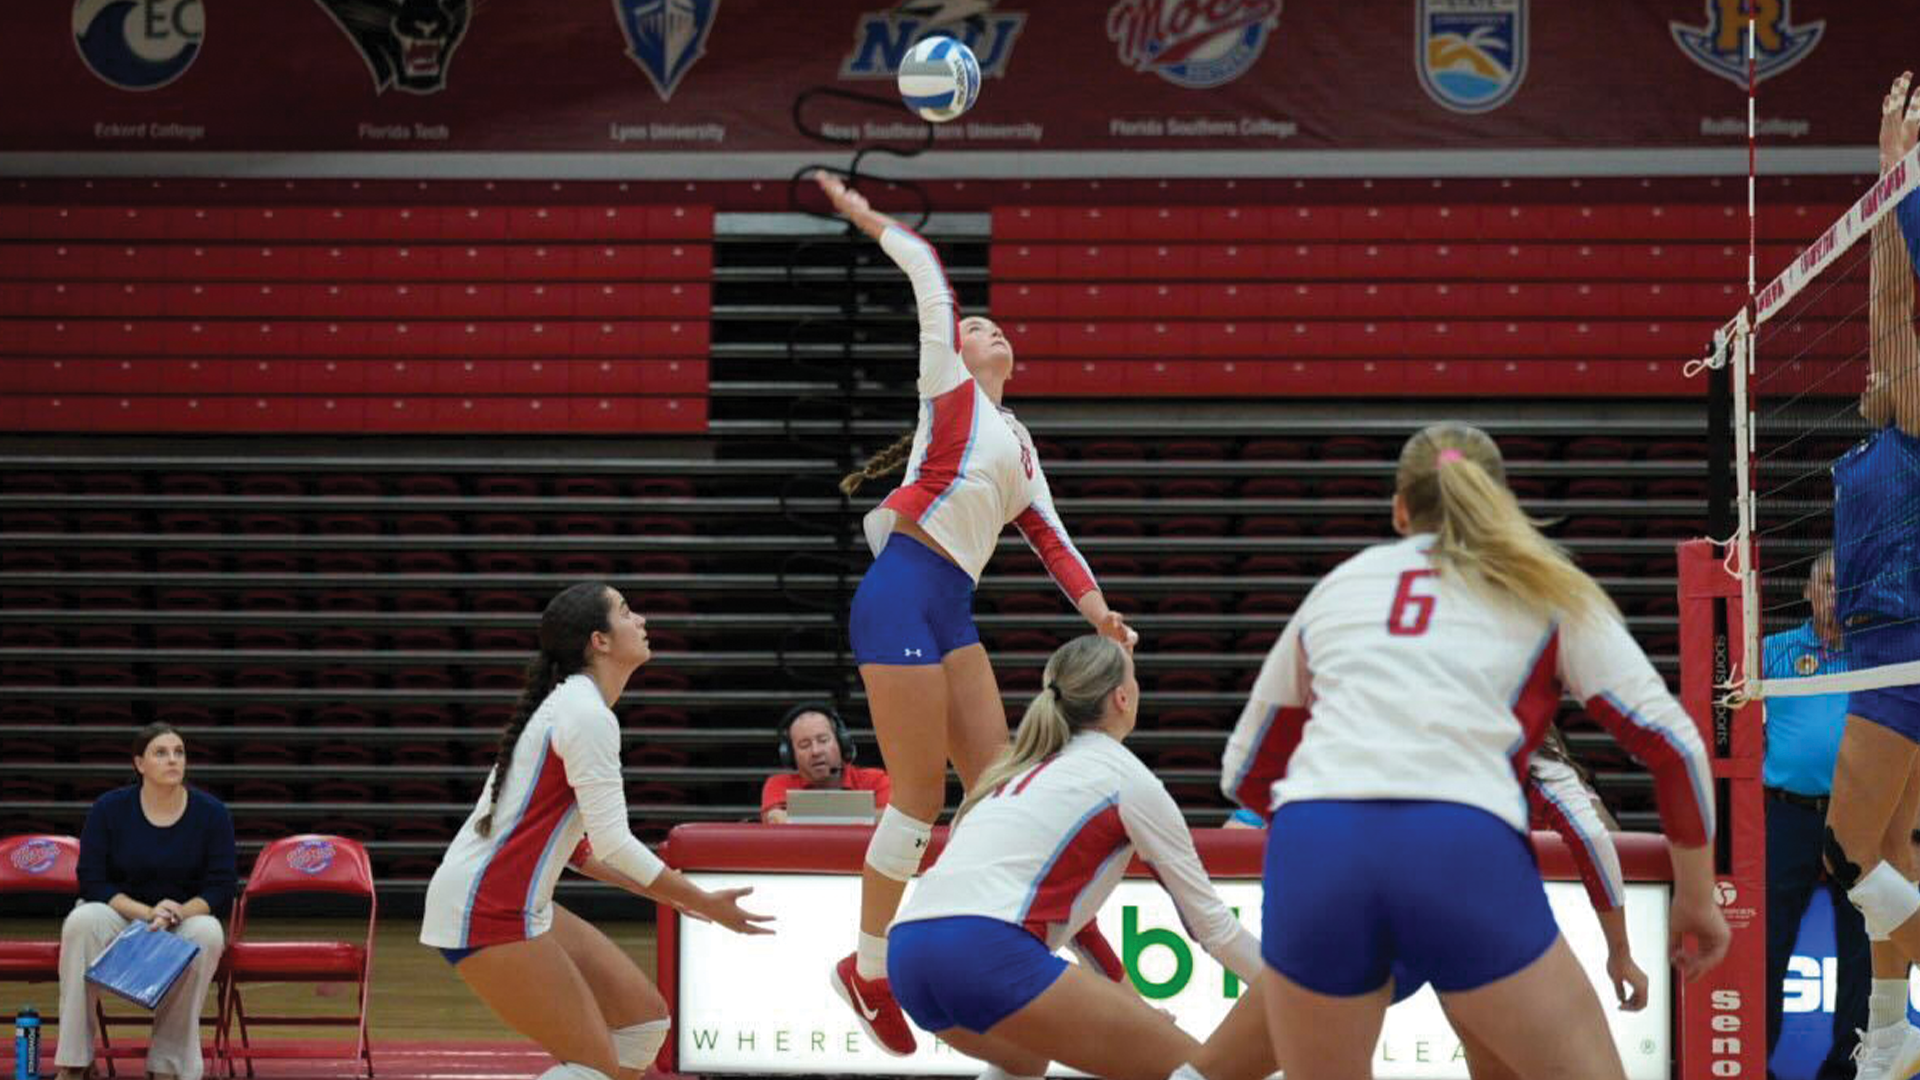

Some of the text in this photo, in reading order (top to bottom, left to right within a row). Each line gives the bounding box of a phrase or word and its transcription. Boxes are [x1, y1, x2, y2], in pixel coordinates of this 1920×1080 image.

[848, 17, 1020, 74] NU
[149, 122, 206, 141] College
[358, 122, 449, 140] Florida Tech
[609, 122, 726, 143] Lynn University
[863, 122, 964, 140] Southeatern
[966, 122, 1044, 143] University
[1110, 118, 1298, 140] Florida Southern College
[1387, 568, 1440, 637] 6
[692, 1029, 861, 1053] WHERE
